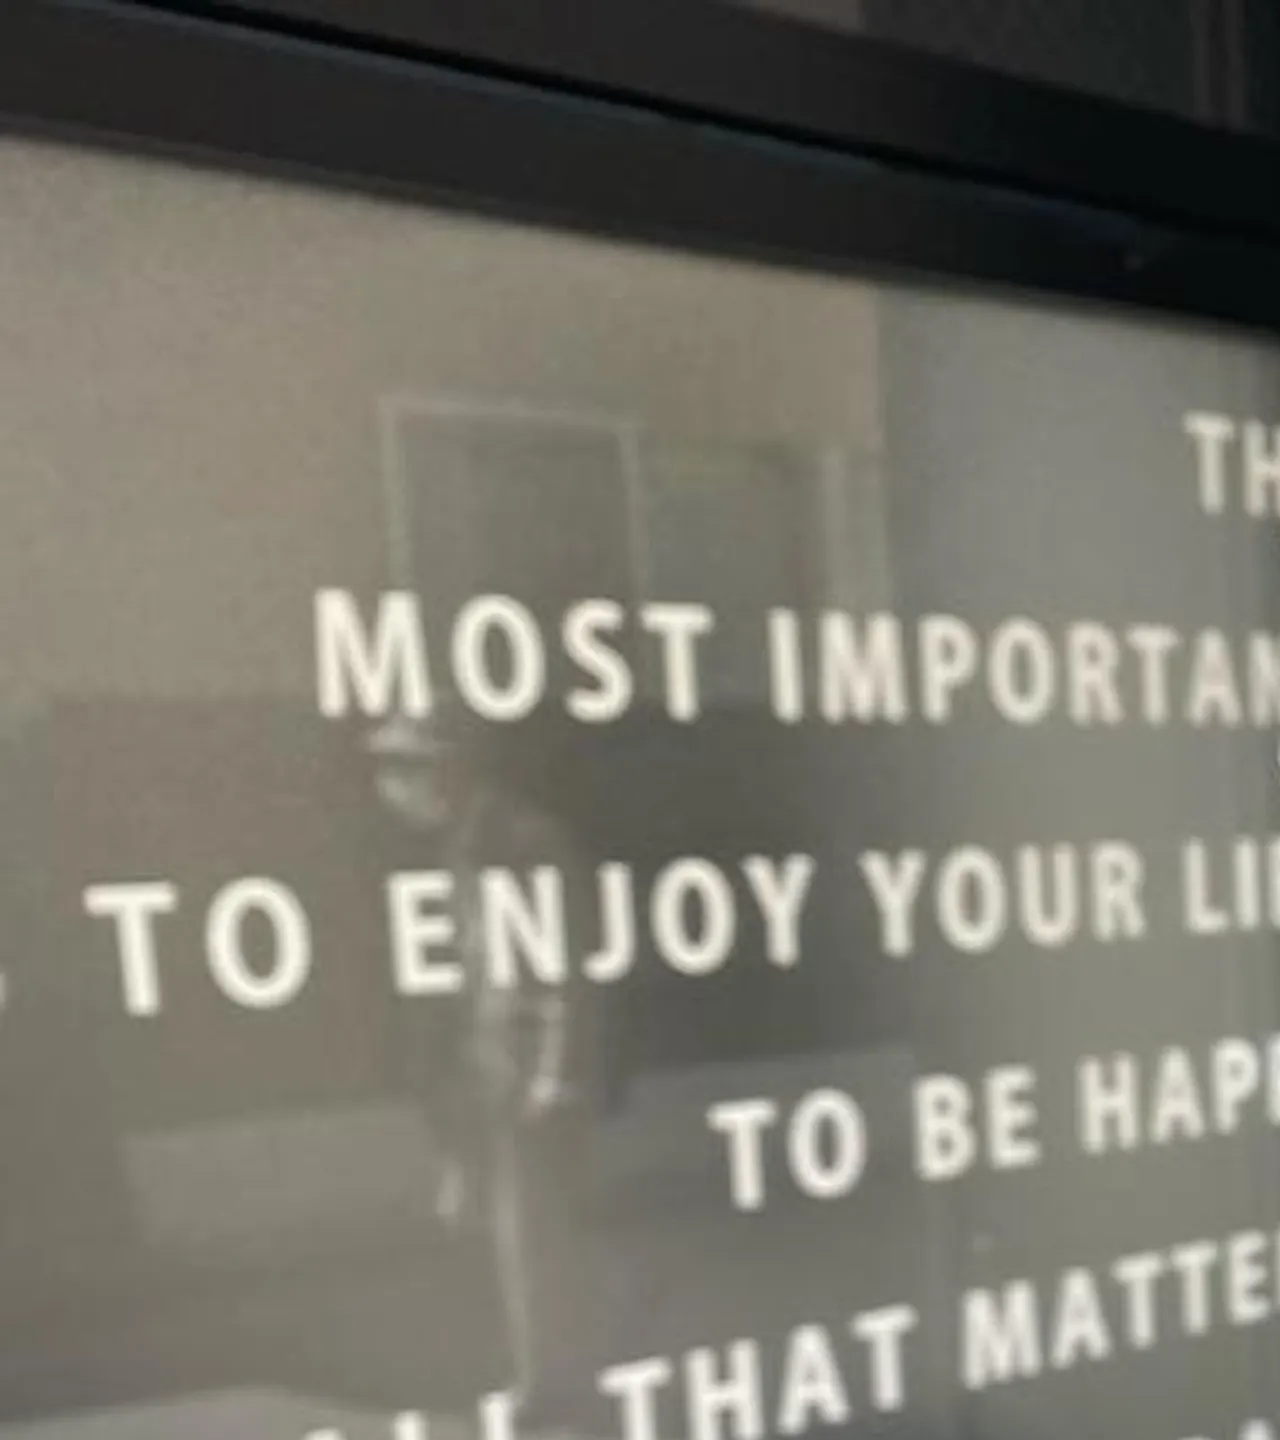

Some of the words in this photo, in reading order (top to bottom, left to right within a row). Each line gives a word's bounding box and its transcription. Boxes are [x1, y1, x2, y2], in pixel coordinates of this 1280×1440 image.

[313, 587, 712, 723] MOST
[83, 877, 312, 1017] TO
[388, 853, 813, 996] ENJOY
[859, 842, 1147, 959] YOUR
[708, 1088, 866, 1211] TO
[911, 1067, 1041, 1181] BE
